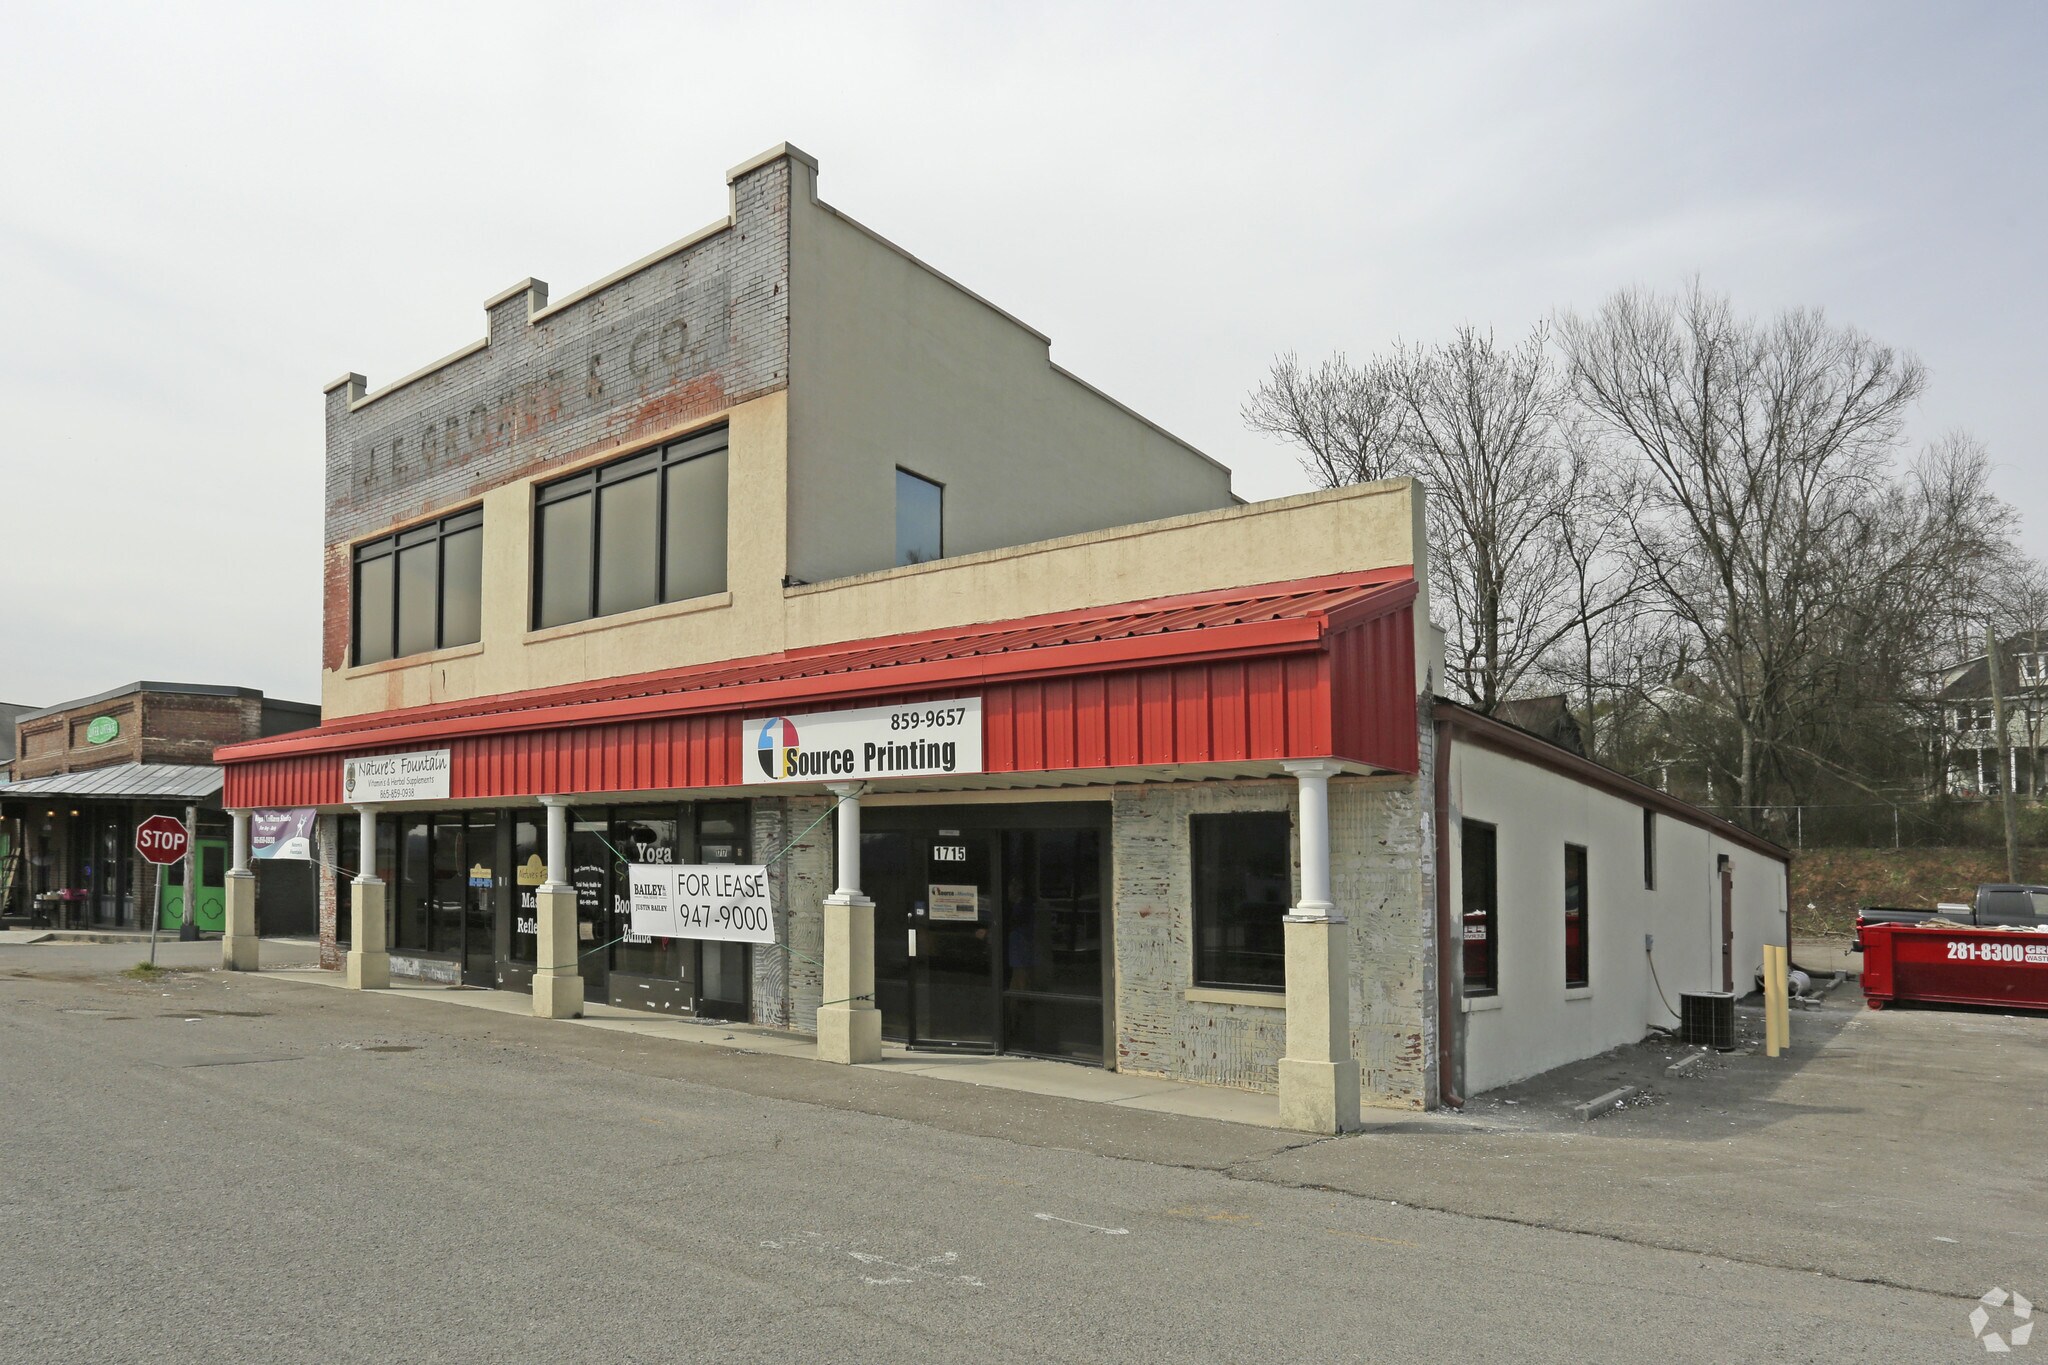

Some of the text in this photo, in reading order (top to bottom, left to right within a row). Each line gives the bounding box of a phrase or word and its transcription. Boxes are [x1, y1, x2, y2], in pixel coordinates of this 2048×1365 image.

[891, 708, 966, 730] 859-9657
[359, 751, 447, 776] Nature's Fountain
[787, 748, 854, 777] Source
[864, 739, 956, 772] Printing
[391, 778, 405, 786] Herbal
[406, 776, 434, 787] Supplements
[380, 788, 414, 798] 865-859-0938
[140, 829, 185, 850] STOP
[636, 843, 673, 865] Yoga
[936, 847, 964, 860] 1715
[634, 884, 662, 896] BAILEY
[678, 874, 765, 898] FOR LEASE
[635, 904, 650, 912] JUSTIN
[680, 904, 768, 931] 947-9000
[1947, 942, 2048, 962] 281-8300 GR
